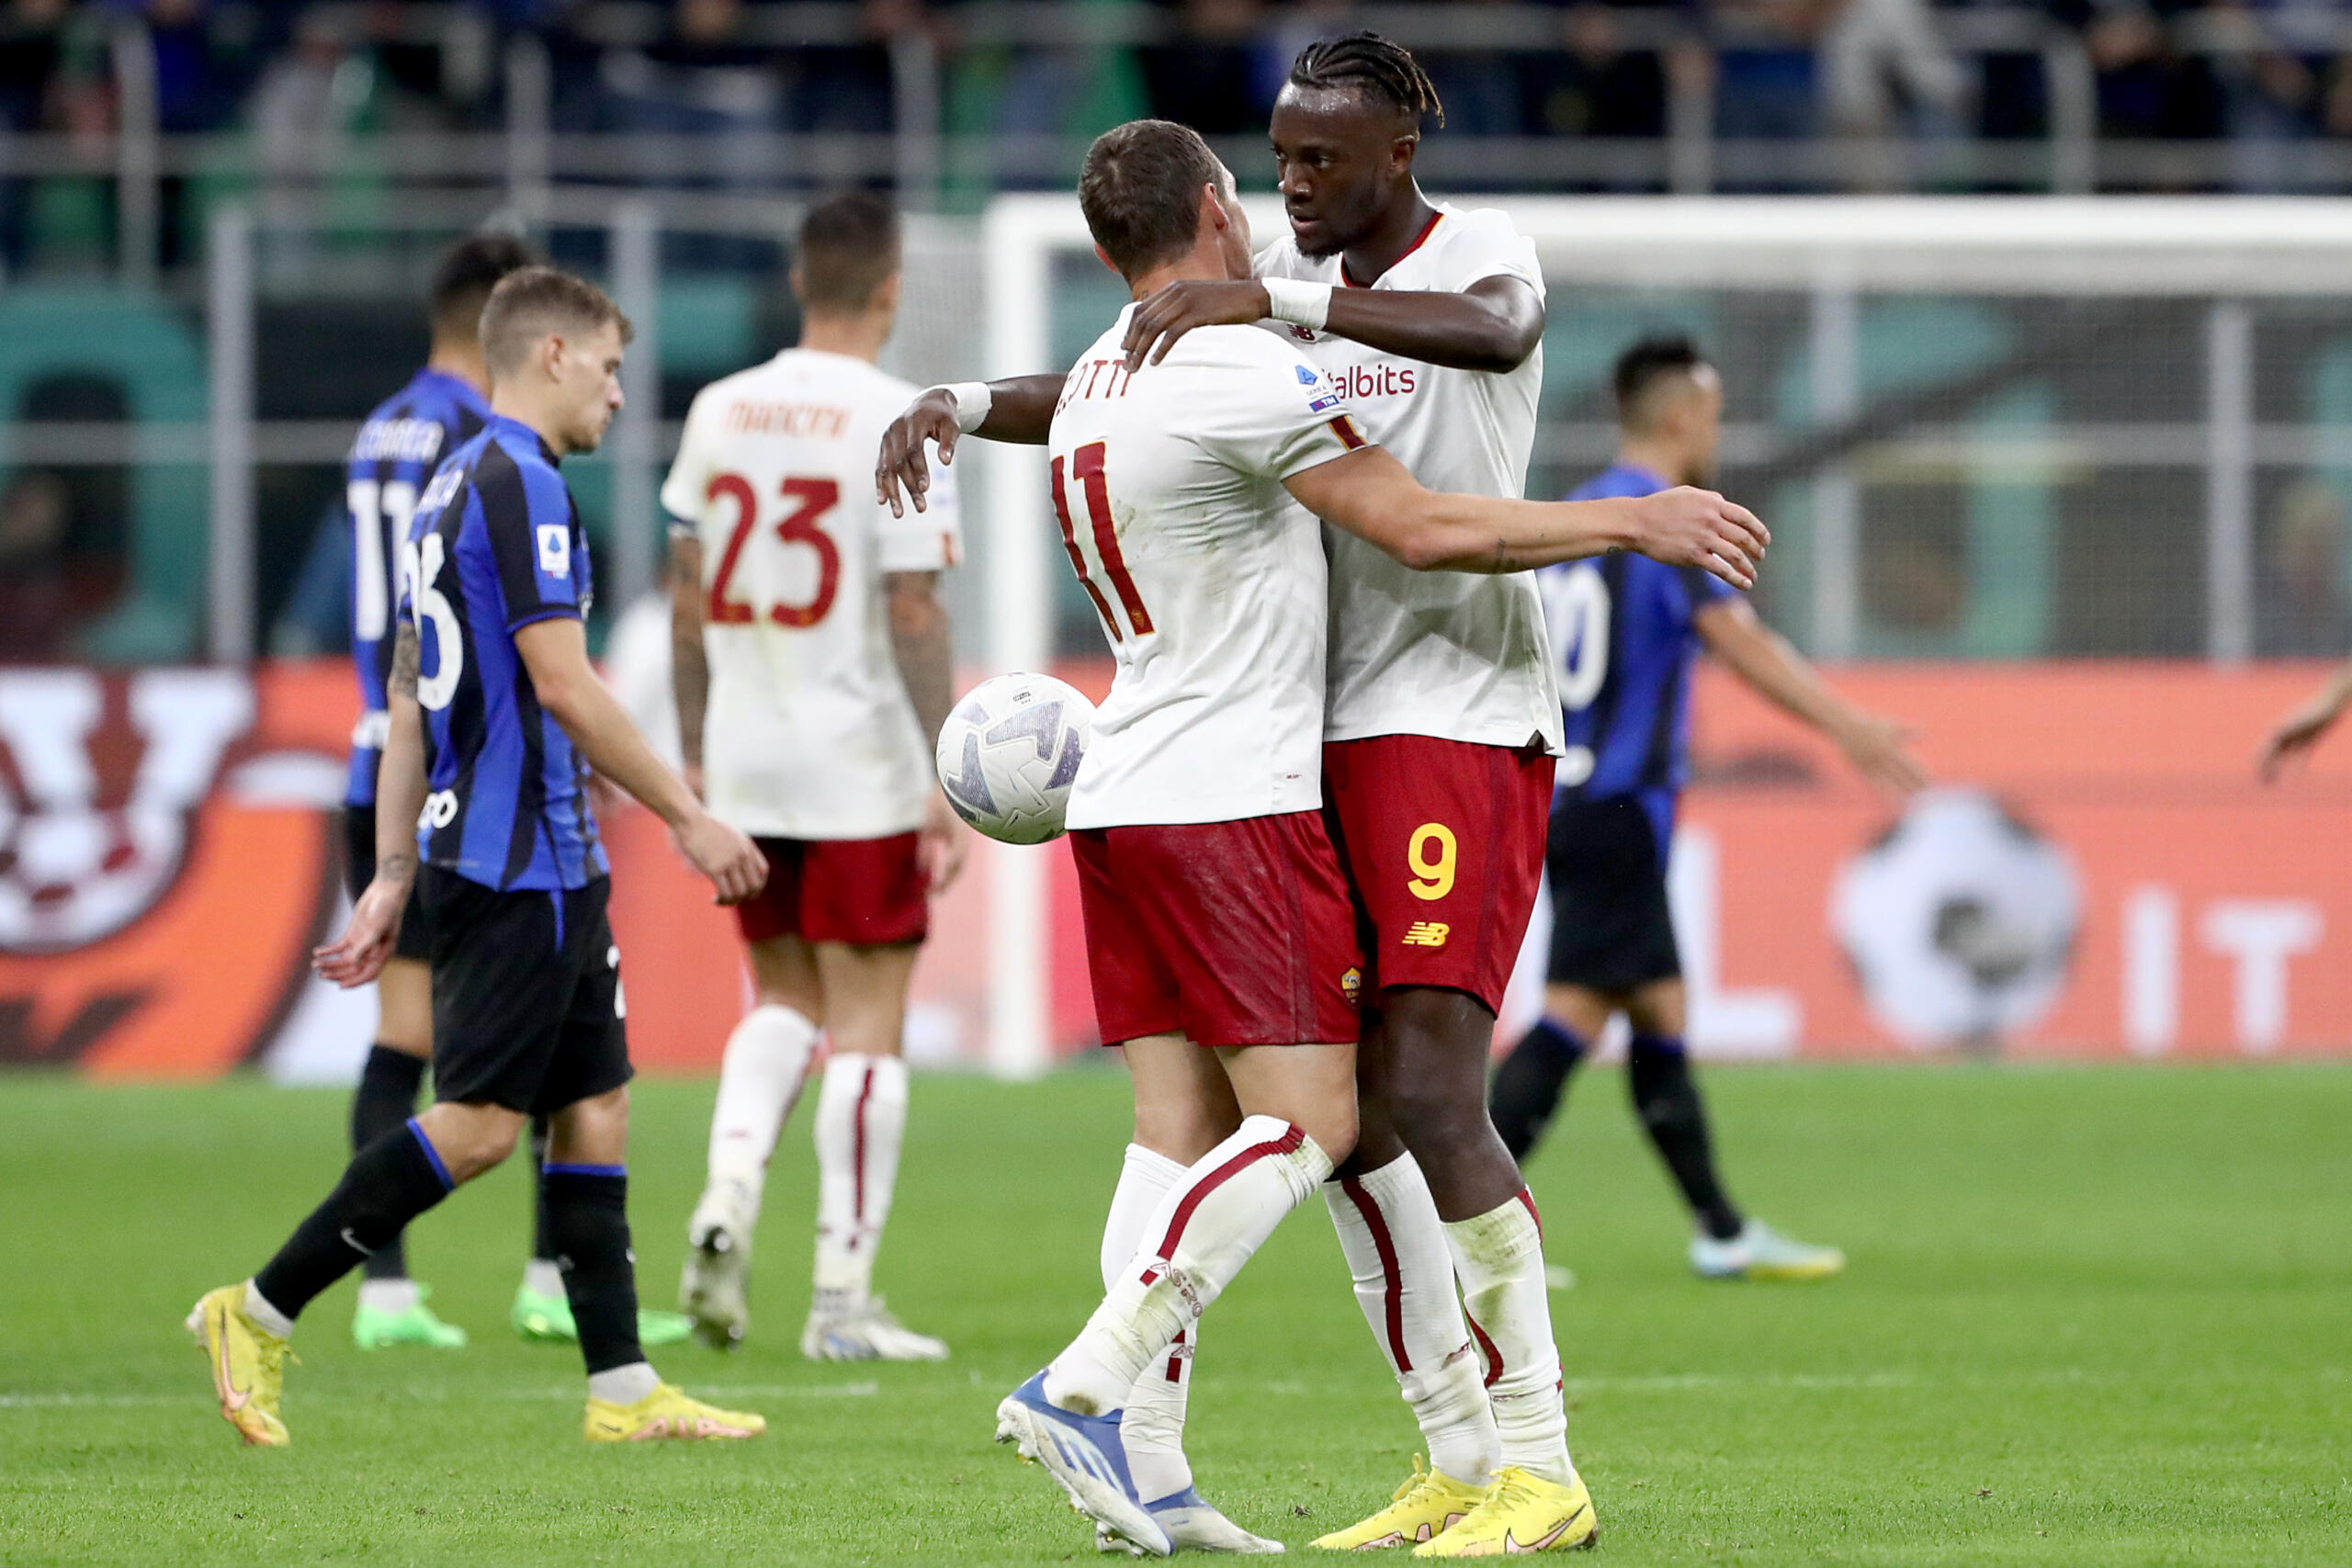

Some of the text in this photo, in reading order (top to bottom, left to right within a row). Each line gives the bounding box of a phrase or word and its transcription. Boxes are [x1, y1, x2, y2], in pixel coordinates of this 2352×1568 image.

[706, 473, 840, 628] 23
[1051, 441, 1155, 643] 11
[1408, 822, 1457, 900] 9
